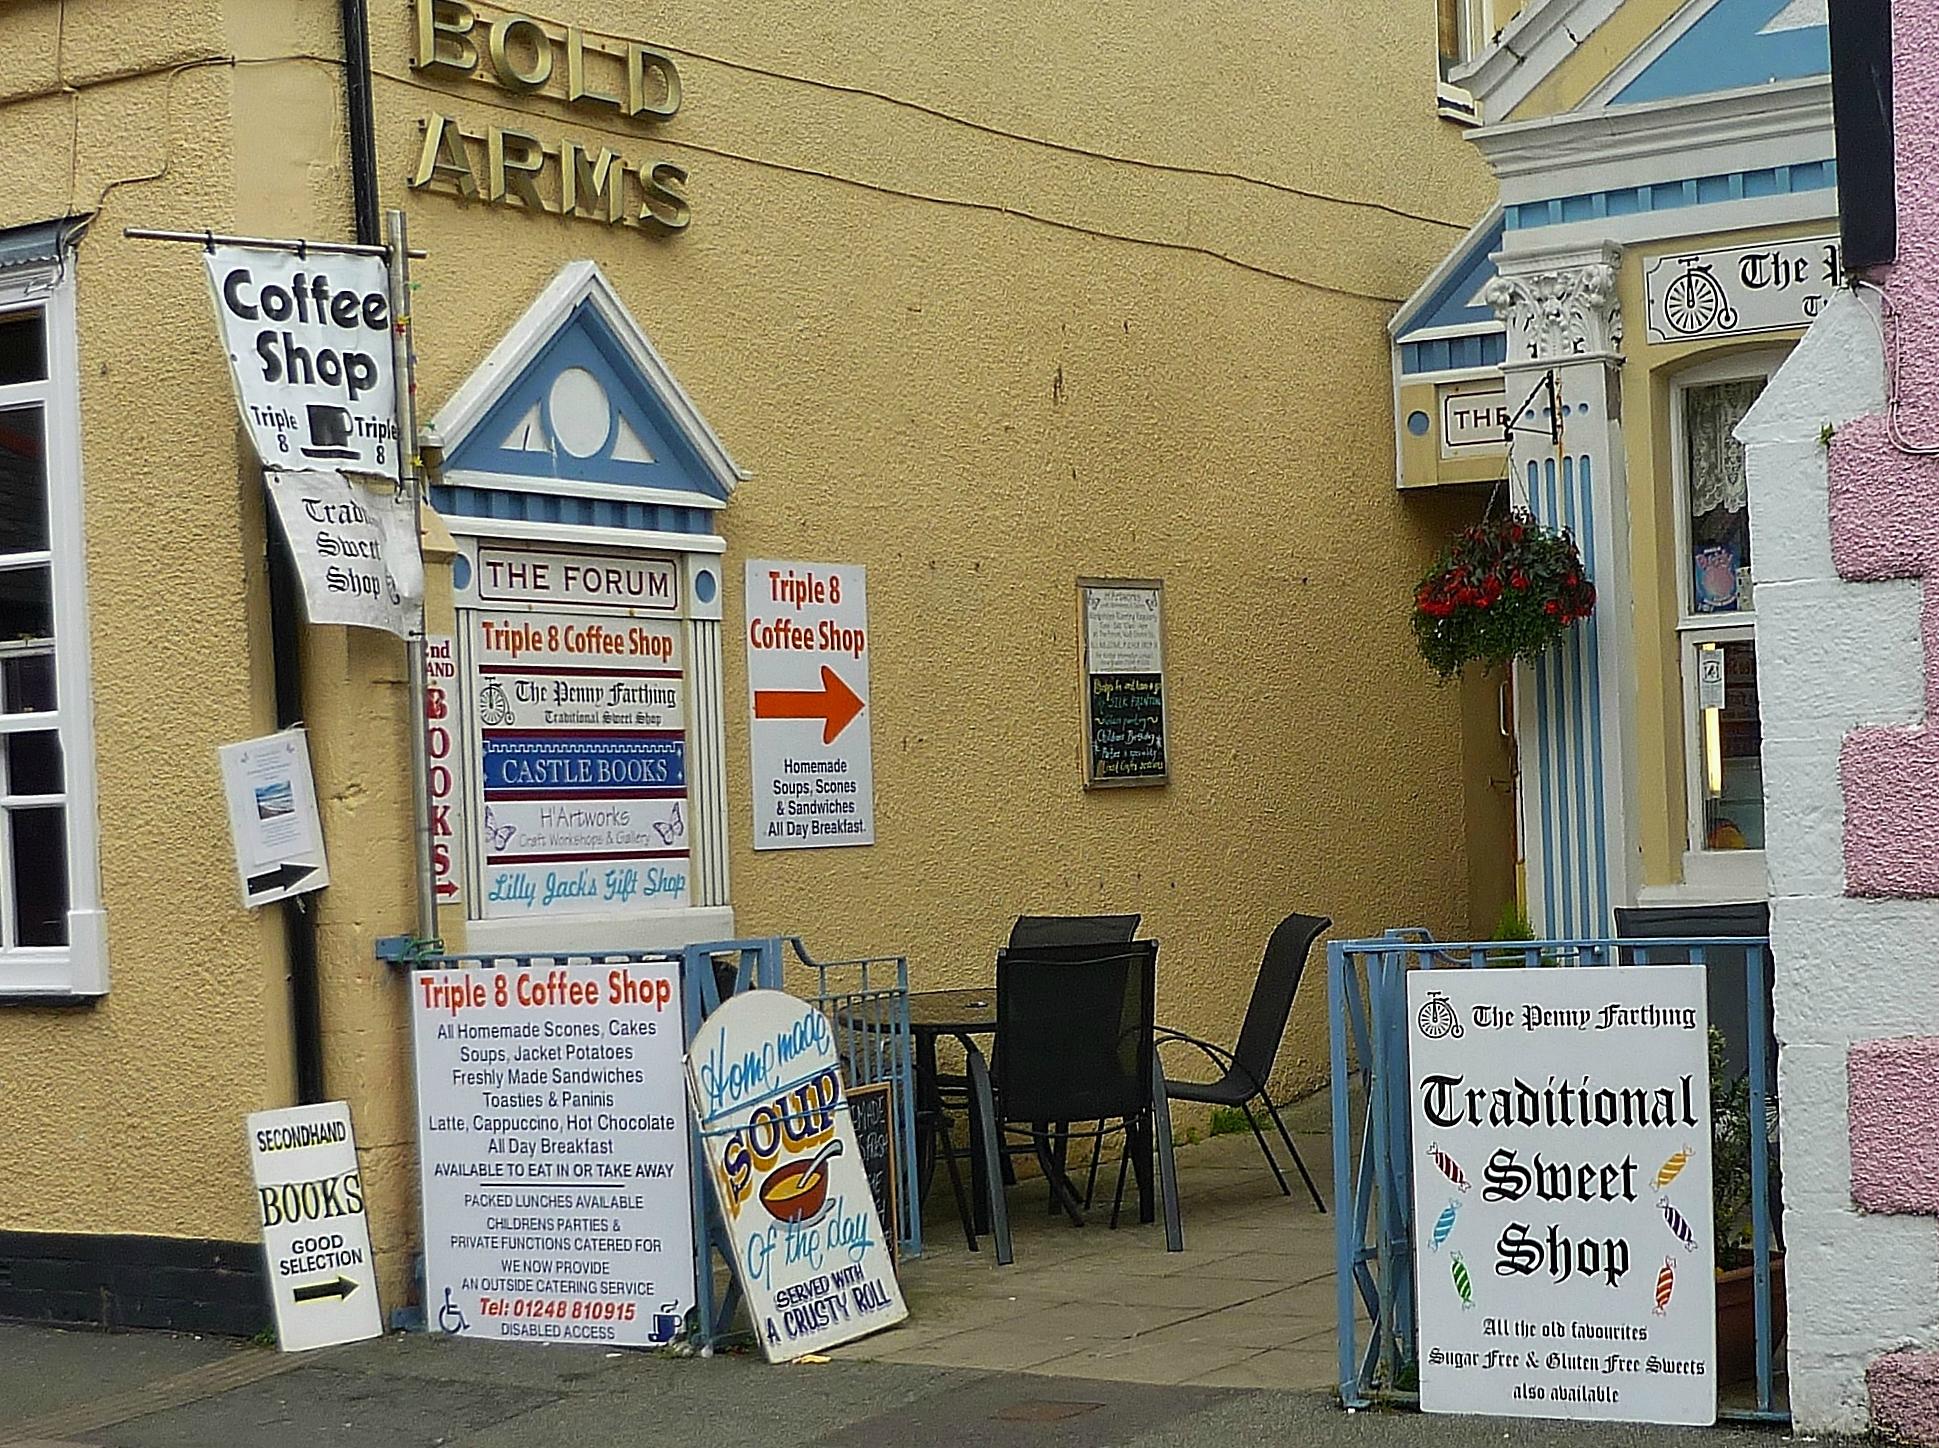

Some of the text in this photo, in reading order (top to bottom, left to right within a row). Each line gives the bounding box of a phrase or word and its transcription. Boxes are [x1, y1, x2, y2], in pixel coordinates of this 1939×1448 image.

[417, 0, 681, 117] BOLD
[416, 112, 691, 228] ARMS
[1739, 251, 1808, 291] The
[224, 269, 388, 330] Coffee
[256, 330, 378, 400] Shop
[251, 405, 298, 431] Triple
[355, 417, 398, 442] Triple
[1454, 407, 1507, 429] THE
[278, 434, 289, 452] 8
[376, 446, 385, 464] 8
[316, 531, 382, 560] Sweet
[326, 566, 380, 599] Shop
[486, 562, 669, 597] THE FORUM
[769, 571, 840, 610] Triple 8
[425, 640, 451, 659] nd
[482, 621, 672, 663] Triple 8 Coffee Shop
[751, 618, 865, 659] Coffee Shop
[515, 678, 676, 708] The Penny Farthing
[545, 710, 662, 725] Traditional Sweet Shop
[503, 759, 668, 783] CASTLE BOOKS
[784, 758, 847, 775] Homemade
[426, 688, 452, 876] BOOKS
[773, 778, 856, 798] Soups, Scones
[540, 806, 630, 828] H'Artworks
[776, 799, 855, 816] & Sandwiches
[768, 821, 783, 837] All
[787, 820, 808, 839] Day
[489, 867, 685, 908] Lilly Jack's Gift Shop
[421, 968, 671, 1017] Triple 8 Coffee Shop
[437, 1019, 656, 1040] All Homemade Scones, Cakes
[1472, 1003, 1696, 1031] The Penny Farthing
[460, 1044, 633, 1066] Soups, Jacket Potatoes
[453, 1067, 644, 1089] Freshly Made Sandwiches
[483, 1092, 614, 1108] Toasties & Paninis
[1420, 1074, 1699, 1128] Traditional
[429, 1114, 675, 1134] Latte, Cappuccino, Hot Chocolate
[257, 1121, 346, 1153] SECONDHAND
[488, 1138, 614, 1158] All Day Breakfast
[723, 1069, 841, 1208] SOUP
[435, 1163, 675, 1178] AVAILABLE TO EAT IN OR TAKE AWAY
[1483, 1148, 1638, 1202] Sweet
[259, 1174, 364, 1227] BOOKS
[464, 1194, 644, 1209] PACKED LUNCHES AVAILABLE
[486, 1217, 621, 1232] CHILDRENS PARTIES &
[786, 1208, 824, 1271] the
[827, 1196, 874, 1262] day
[292, 1235, 343, 1254] GOOD
[451, 1236, 662, 1252] PRIVATE FUNCTIONS CATERED FOR
[1495, 1222, 1629, 1287] Shop
[280, 1248, 363, 1276] SELECTION
[501, 1260, 610, 1275] WE NOW PROVIDE
[462, 1278, 655, 1295] AN OUTSIDE CATERING SERVICE
[775, 1263, 864, 1310] SERVED WITH
[480, 1297, 636, 1321] Tel: 01248 810915
[767, 1279, 891, 1344] A CRUSTY ROLL
[501, 1323, 615, 1339] DISABLED ACCESS
[1482, 1318, 1648, 1340] All the old favourites
[1428, 1348, 1705, 1376] Sugar Free & Gluten Free Sweets
[1513, 1383, 1619, 1403] also available
